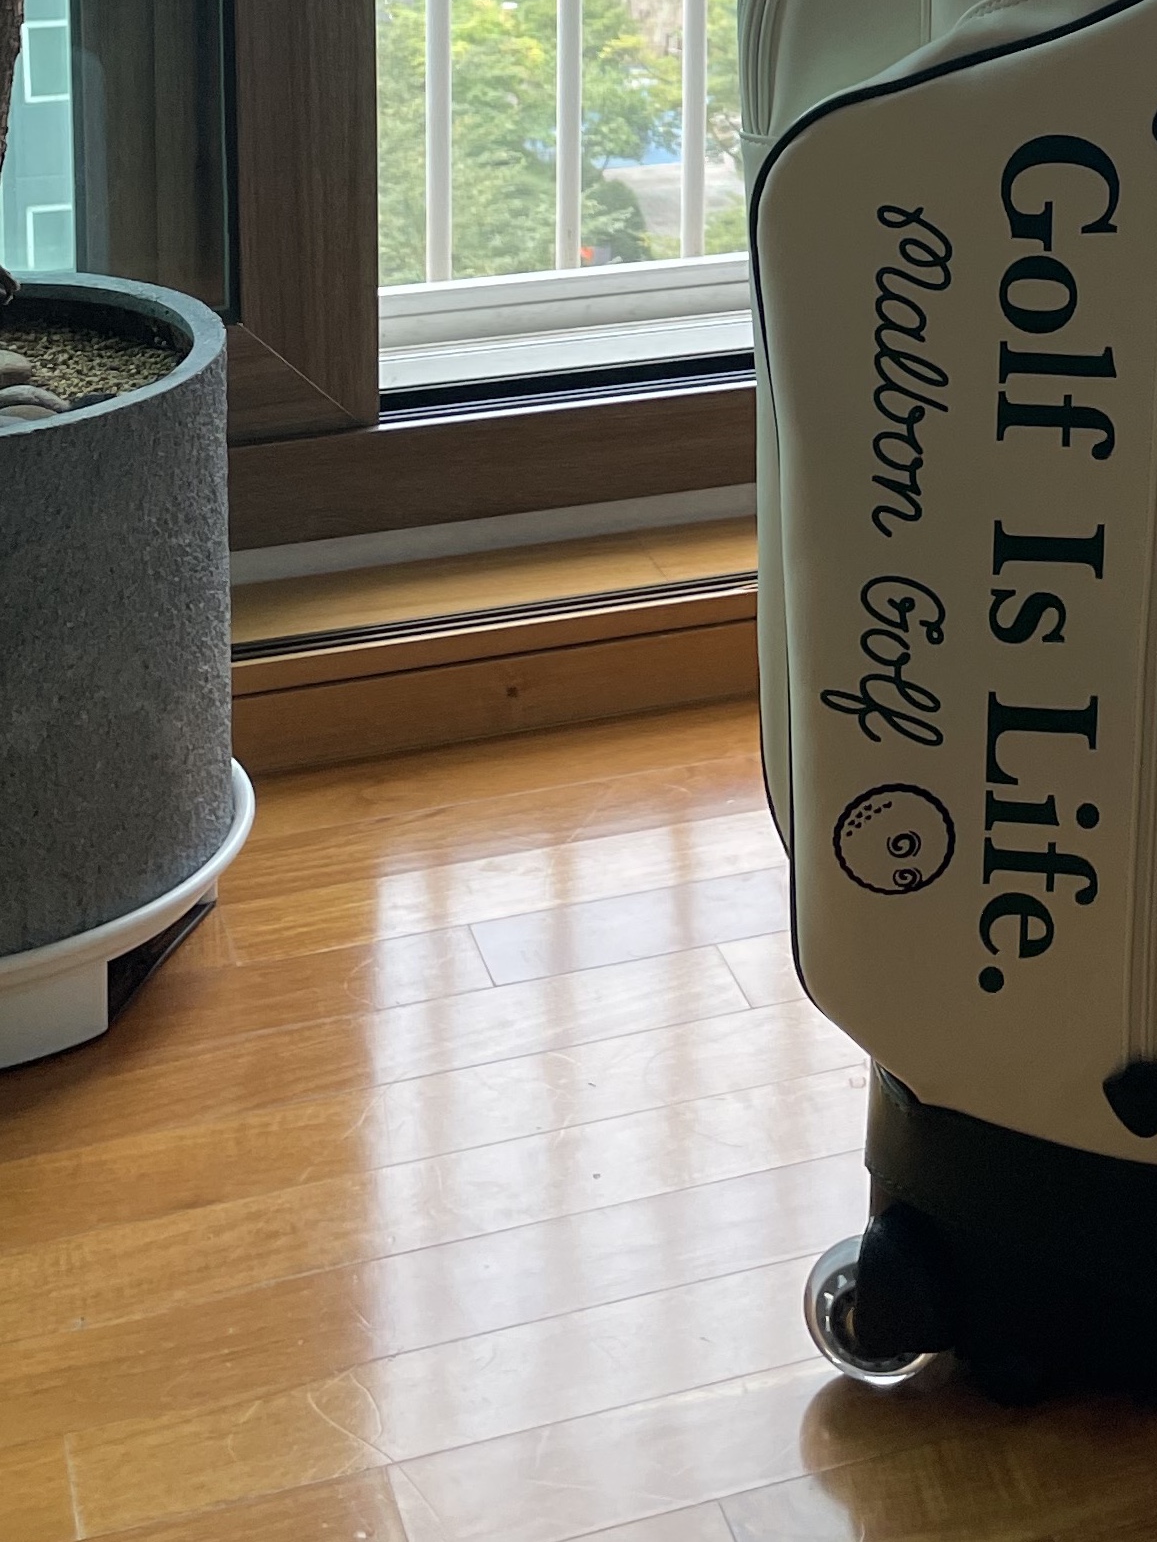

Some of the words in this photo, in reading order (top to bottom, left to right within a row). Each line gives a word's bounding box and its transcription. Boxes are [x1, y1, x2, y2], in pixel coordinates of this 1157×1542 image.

[872, 204, 953, 538] Malbon
[997, 134, 1120, 461] Golf
[820, 575, 946, 747] Golf
[989, 519, 1105, 645] Is
[979, 691, 1100, 994] Life.
